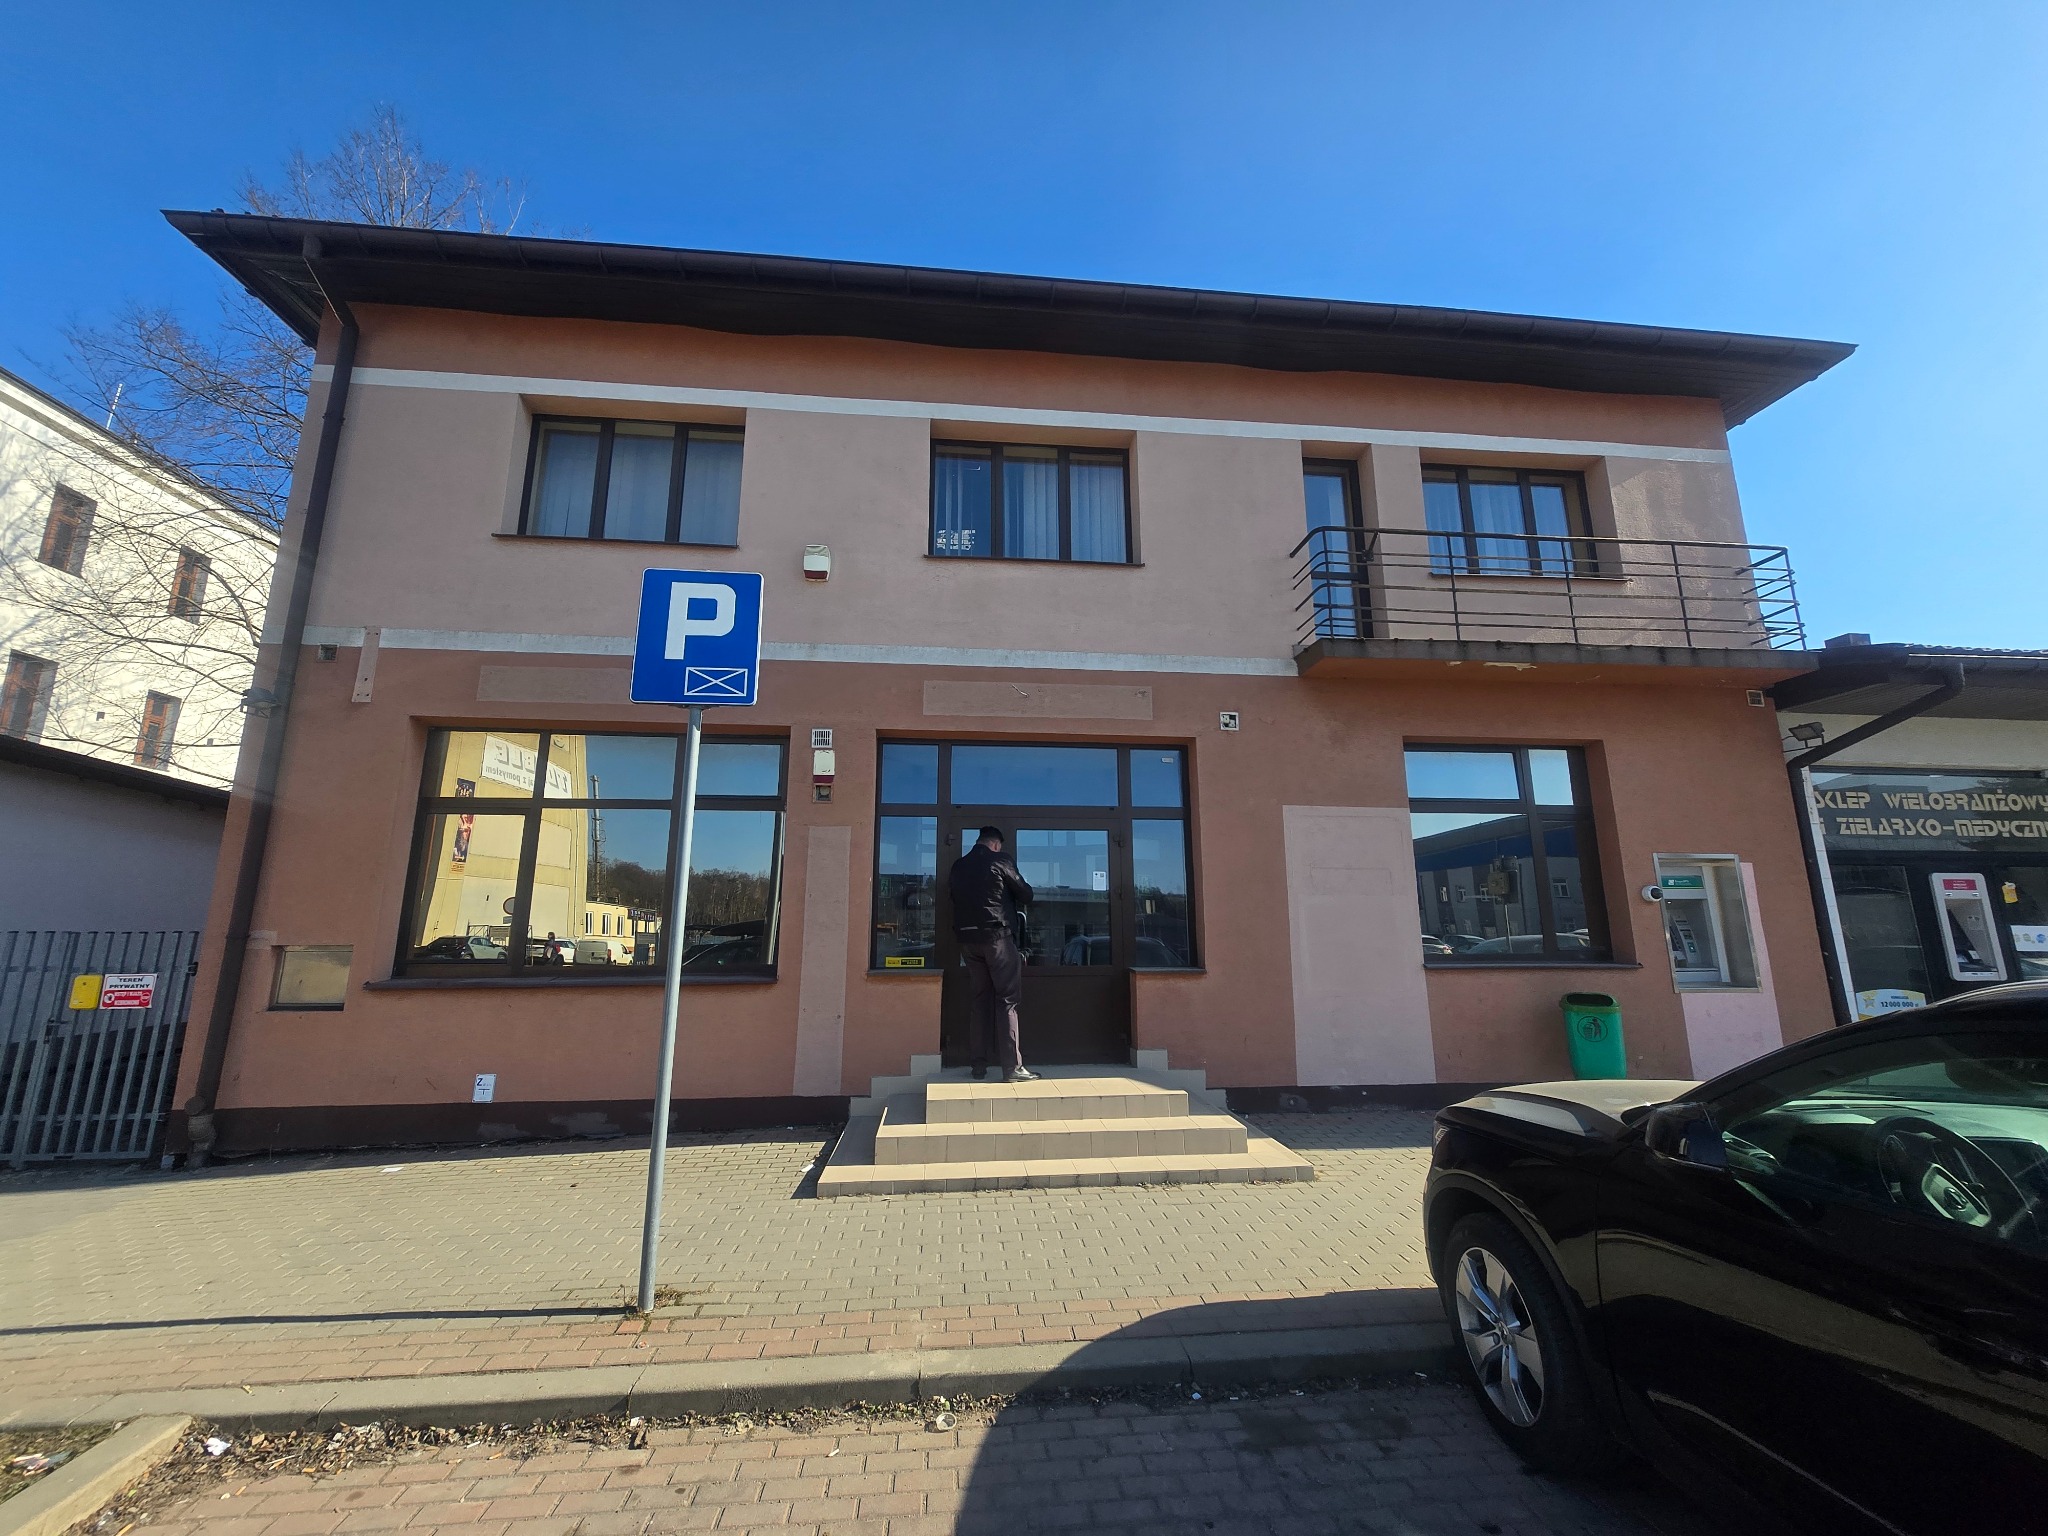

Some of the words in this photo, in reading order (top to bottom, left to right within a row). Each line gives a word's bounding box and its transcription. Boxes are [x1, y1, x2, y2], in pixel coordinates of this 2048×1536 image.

[664, 582, 736, 660] P
[1814, 791, 1871, 809] SKLEP
[1882, 789, 2048, 812] WIELOBRANŻOWY
